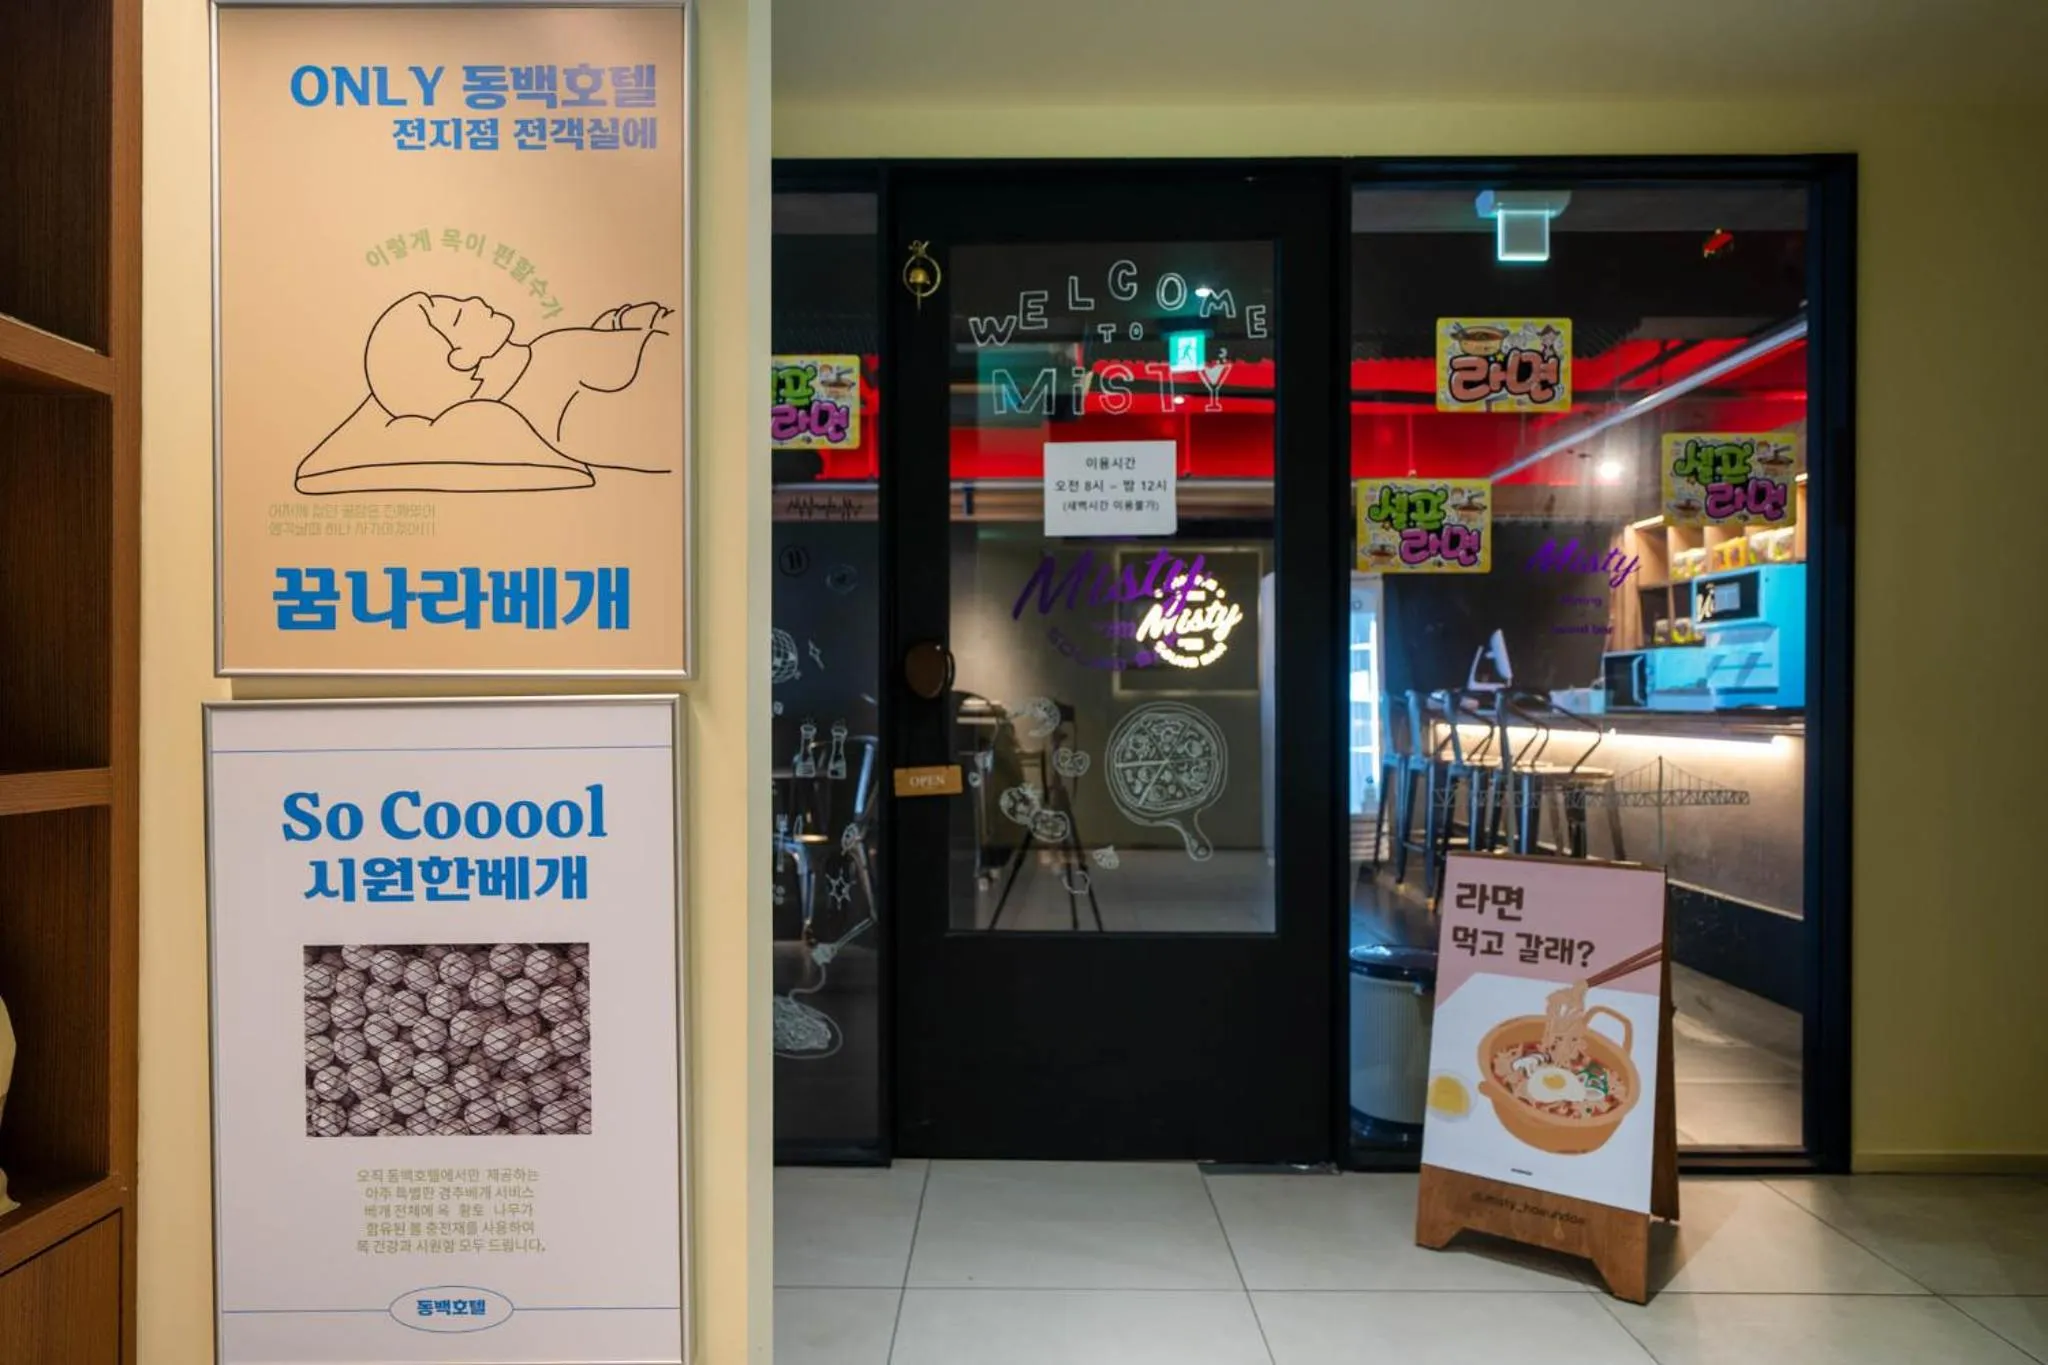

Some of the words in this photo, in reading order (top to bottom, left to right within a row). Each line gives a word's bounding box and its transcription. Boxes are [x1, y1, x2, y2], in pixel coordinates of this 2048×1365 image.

[290, 64, 445, 107] ONLY
[462, 63, 657, 109] 동백호텔
[393, 117, 500, 151] 전지점
[513, 117, 657, 151] 전객실에
[365, 228, 432, 267] 이렇게
[440, 228, 486, 257] 목이
[968, 259, 1268, 348] WELCOME
[1097, 322, 1144, 343] TO
[772, 364, 817, 408] 프
[1449, 348, 1560, 404] 라면
[772, 399, 850, 443] 라면
[1085, 456, 1137, 471] 이용시간
[1055, 480, 1079, 493] 오전
[1084, 479, 1104, 493] 8시
[1122, 479, 1135, 493] 밤
[1141, 479, 1168, 493] 12시
[1704, 476, 1787, 521] 라면
[1399, 523, 1481, 567] 라면
[1523, 537, 1642, 590] Misty
[272, 566, 631, 631] 꿈나라베개
[1012, 547, 1212, 632] Misty
[1135, 601, 1244, 643] Misty
[909, 775, 946, 789] OPEN
[282, 790, 364, 842] So
[380, 783, 608, 841] Cooool
[303, 855, 588, 903] 시원한베개
[1454, 881, 1525, 922] 라면
[1451, 925, 1505, 958] 먹고
[1516, 932, 1596, 969] 갈래?
[356, 1168, 384, 1183] 오직
[487, 1167, 541, 1183] 제공하는
[365, 1186, 392, 1201] 아주
[494, 1185, 535, 1200] 서비스
[364, 1203, 391, 1218] 베개
[494, 1202, 534, 1218] 나무가
[482, 1220, 535, 1236] 사용하여
[373, 1239, 412, 1255] 건강과
[458, 1238, 487, 1255] 모두
[488, 1238, 547, 1253] 드립니다.
[416, 1299, 486, 1316] 동백호텔
